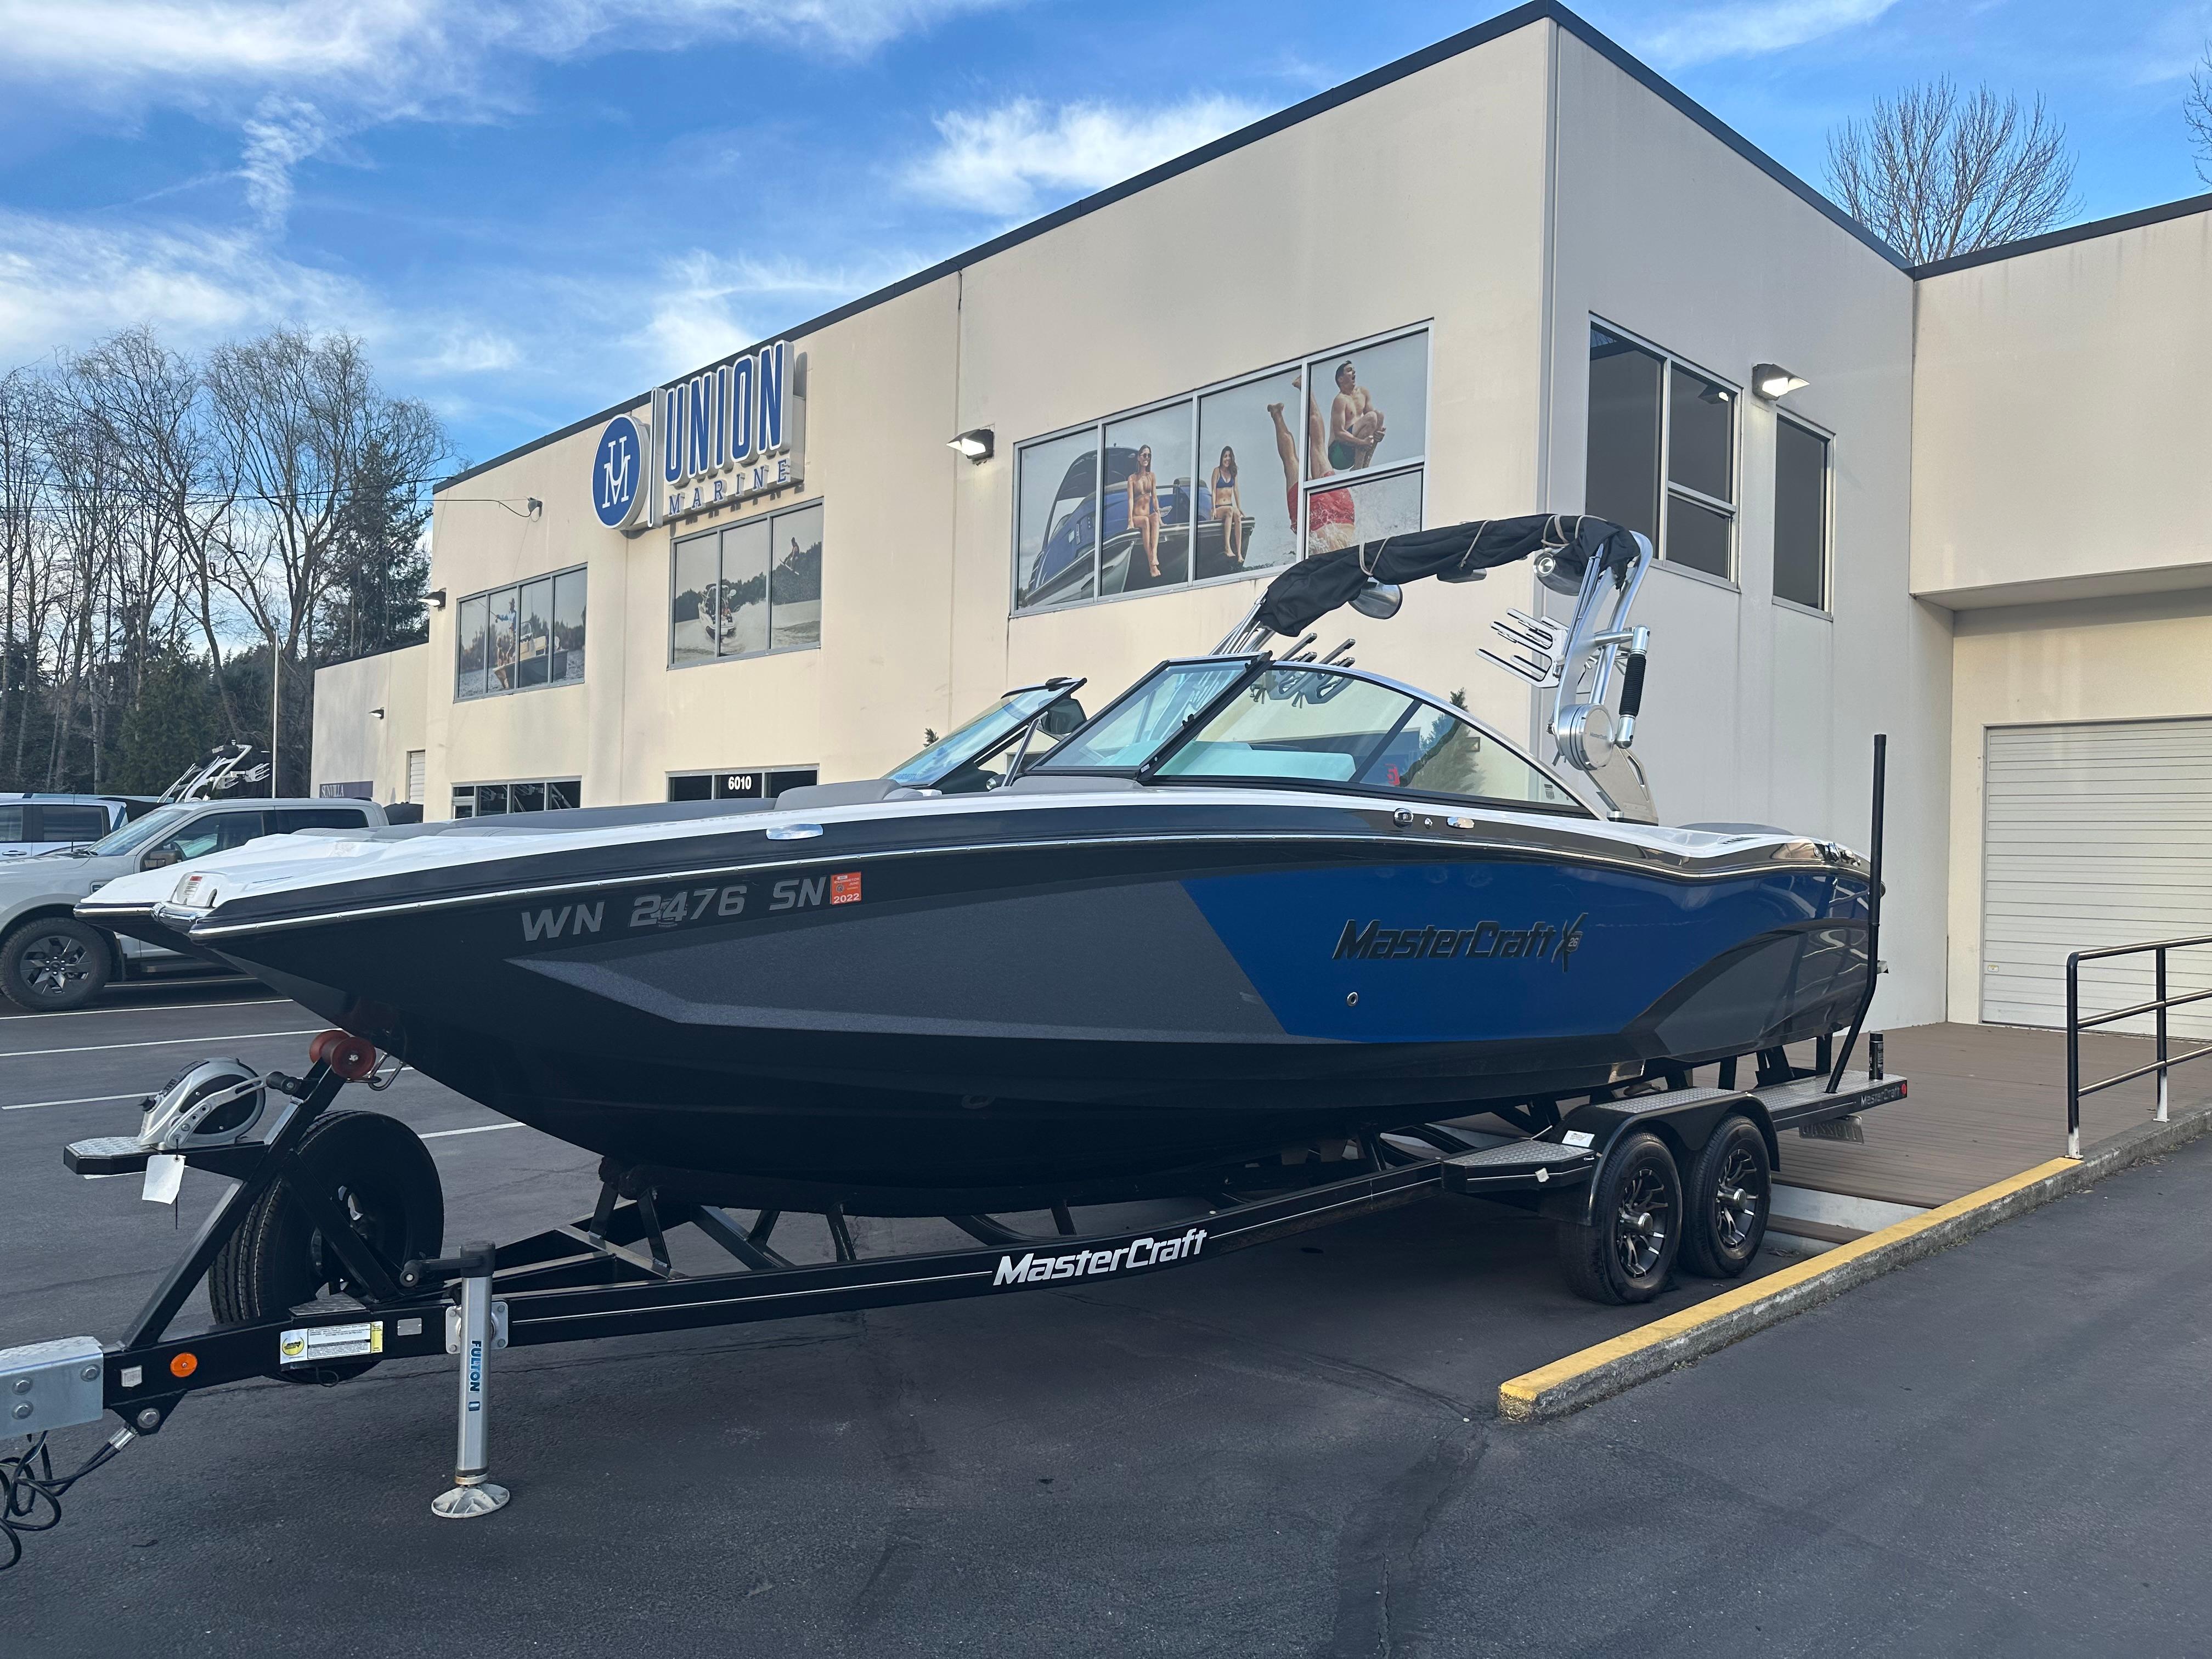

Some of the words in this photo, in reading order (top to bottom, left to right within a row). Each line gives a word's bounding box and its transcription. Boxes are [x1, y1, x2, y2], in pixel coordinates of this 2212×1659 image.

[664, 340, 789, 484] UNION
[669, 459, 789, 516] MARINE
[728, 776, 752, 790] 6010
[521, 901, 605, 942] WN
[629, 884, 748, 927] 2476
[769, 876, 827, 911] SN
[834, 893, 859, 903] 2022
[1332, 919, 1556, 959] MasterCraft
[992, 1228, 1207, 1286] MasterCraft
[470, 1340, 482, 1392] FULTON
